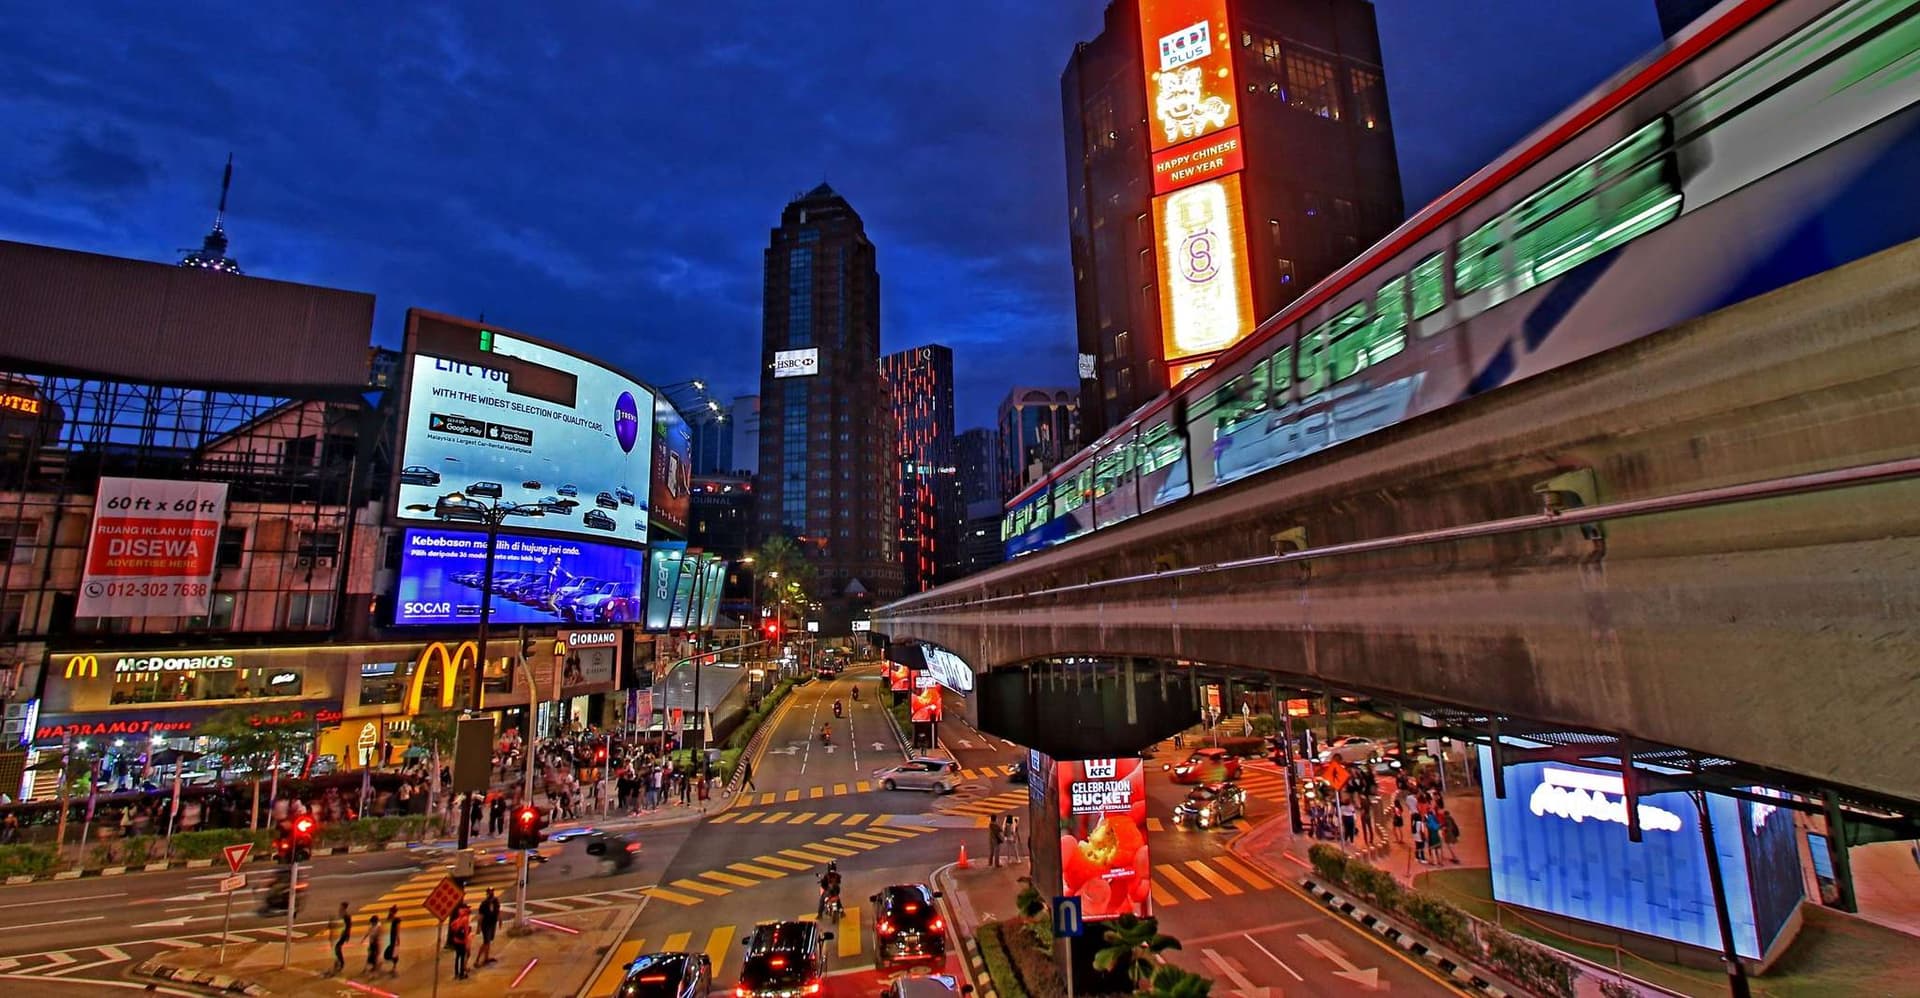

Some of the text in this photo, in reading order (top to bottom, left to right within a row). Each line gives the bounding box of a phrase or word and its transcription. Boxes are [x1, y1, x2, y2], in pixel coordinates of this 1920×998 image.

[1170, 46, 1204, 65] PLUS
[1157, 139, 1237, 173] HAPPY CHINESE
[1171, 158, 1224, 181] NEW YEAR
[777, 359, 801, 369] HSBC
[0, 395, 39, 414] OTEL
[432, 387, 603, 431] WITH THE WIDEST SELECTION OF QUALITY CARS
[447, 423, 482, 435] Google Play
[500, 431, 514, 440] App
[514, 433, 529, 442] Store
[107, 497, 217, 513] 60 ft x 60 ft
[693, 496, 731, 505] OURNAL
[98, 525, 216, 537] RUANG IKLAN UNTUK
[108, 538, 199, 557] DISEWA
[412, 536, 472, 547] Kebebasan
[473, 540, 510, 549] meilih
[511, 541, 520, 551] di
[521, 541, 548, 555] hujung
[548, 545, 561, 555] jari
[106, 558, 198, 568] ADVERTISE HERE
[657, 561, 669, 600] acer
[107, 583, 208, 598] 012-302 7638
[404, 602, 451, 613] SOCAR
[569, 633, 616, 646] GIORDANO
[115, 655, 234, 672] McDonald's
[36, 720, 152, 739] HADRAMOT
[1090, 767, 1111, 776] KFC
[1072, 780, 1130, 793] CELEBRATION
[1072, 791, 1131, 806] BUCKET
